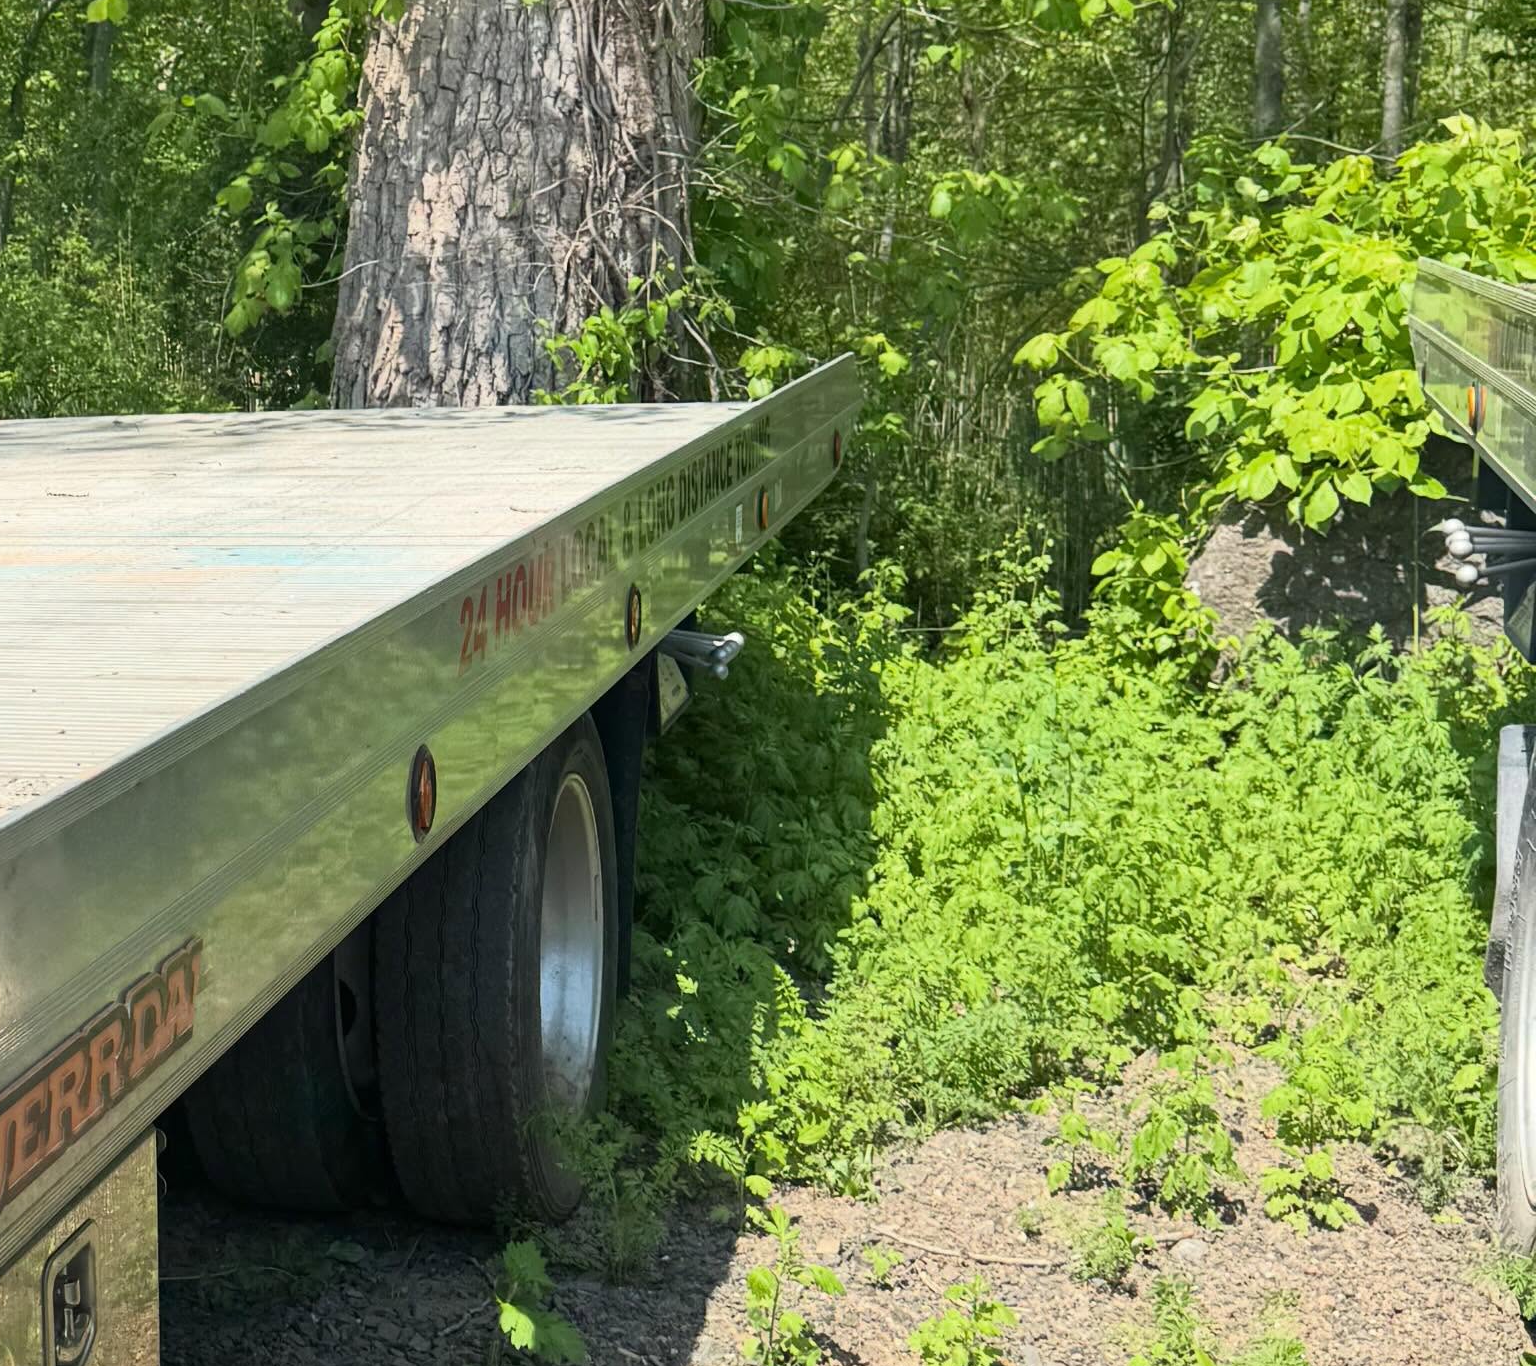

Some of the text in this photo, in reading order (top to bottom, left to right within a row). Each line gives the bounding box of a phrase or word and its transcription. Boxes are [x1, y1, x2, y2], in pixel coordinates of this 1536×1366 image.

[458, 585, 488, 676] 24
[494, 546, 556, 652] HOUR
[622, 500, 634, 559] &
[638, 474, 675, 552] LONG
[679, 438, 733, 523] DISTANCE
